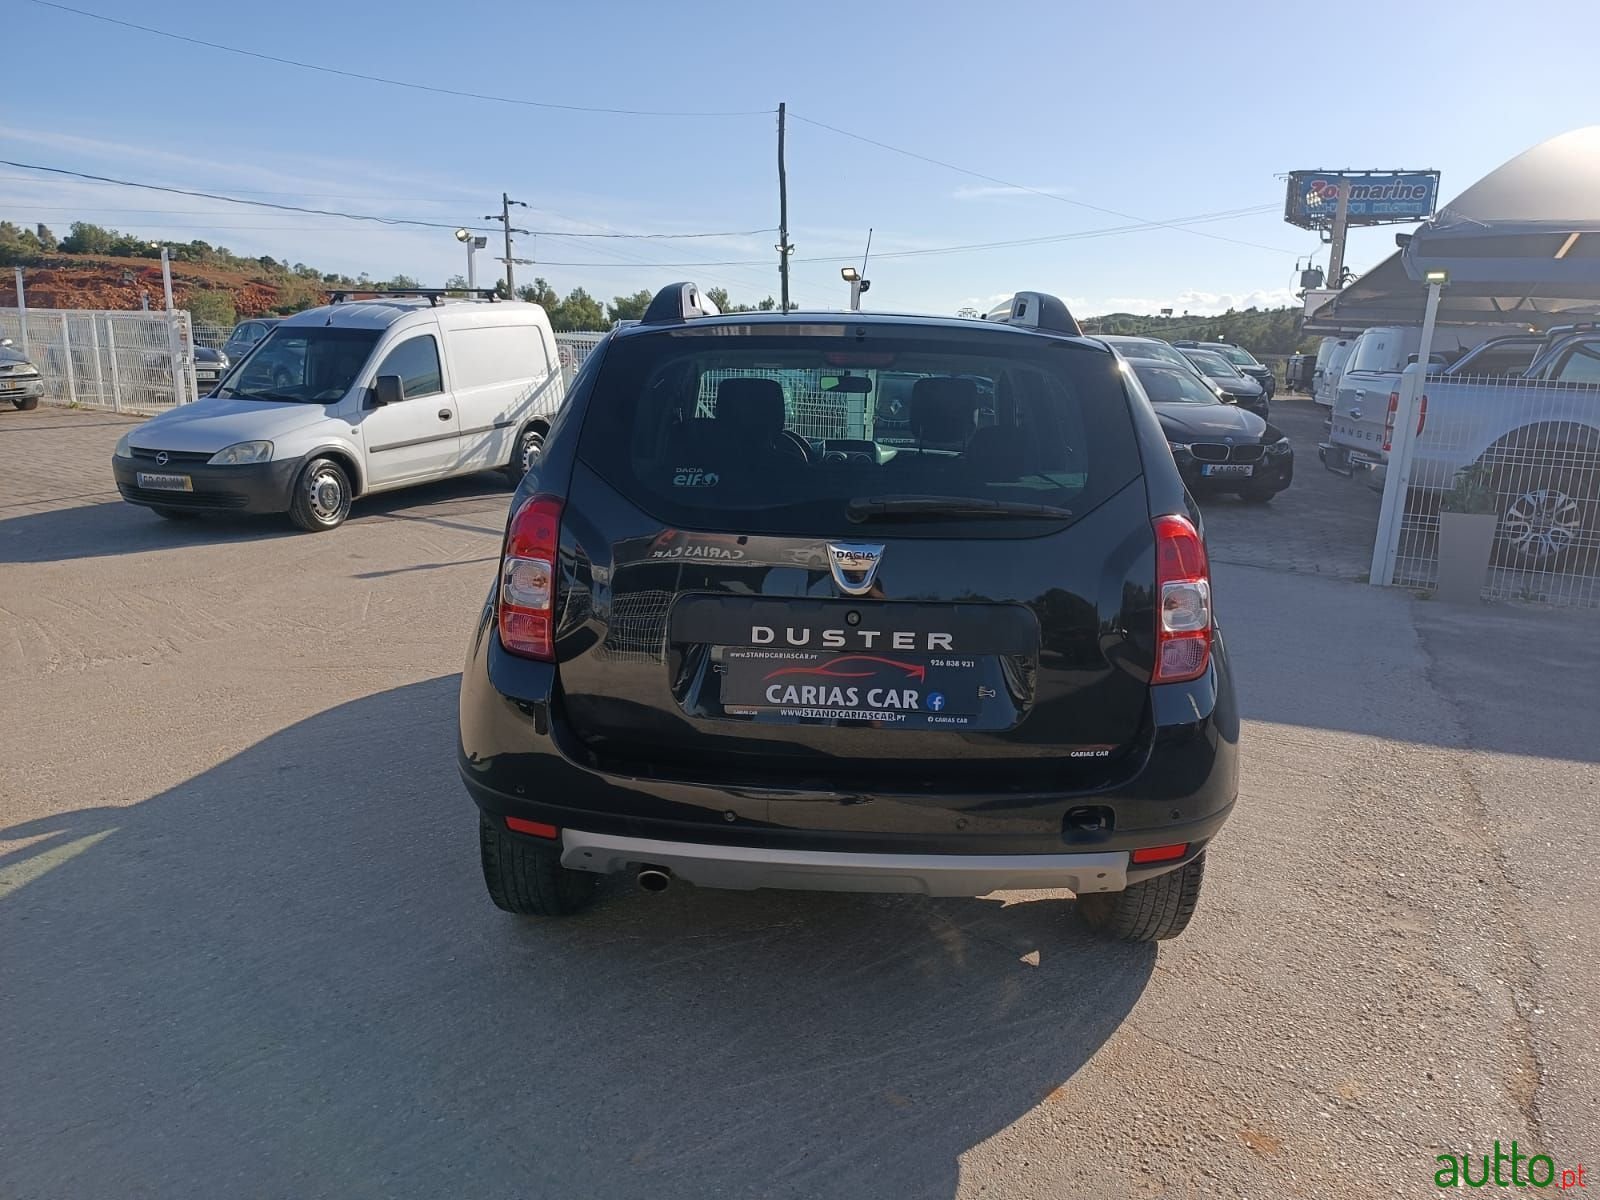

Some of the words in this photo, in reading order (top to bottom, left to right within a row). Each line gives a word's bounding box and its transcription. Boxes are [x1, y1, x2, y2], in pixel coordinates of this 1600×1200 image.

[1306, 180, 1426, 201] Zomarine
[1333, 424, 1383, 442] RANGER
[673, 473, 703, 486] elf
[836, 551, 875, 560] DACIA
[751, 626, 953, 650] DUSTER
[930, 659, 945, 667] 926
[765, 684, 859, 707] CARIAS
[866, 688, 919, 709] CAR
